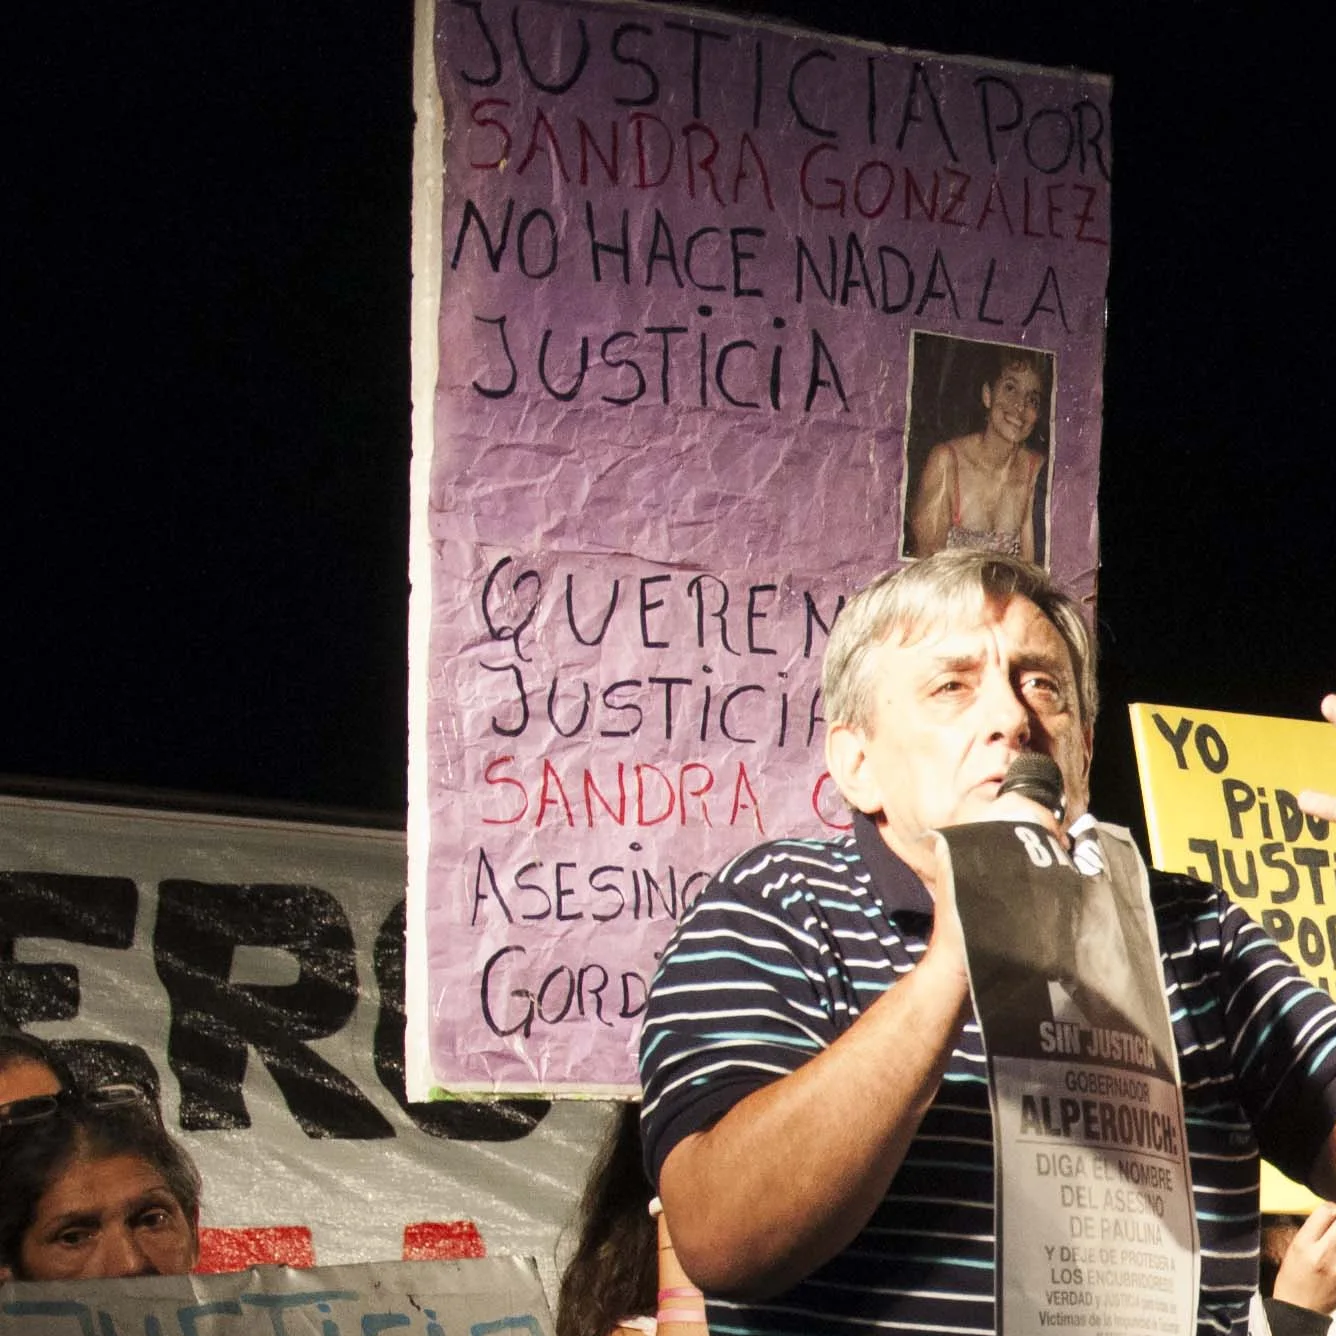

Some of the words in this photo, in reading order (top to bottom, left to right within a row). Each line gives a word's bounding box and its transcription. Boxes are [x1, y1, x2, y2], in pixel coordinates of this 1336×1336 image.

[979, 75, 1112, 182] POR
[469, 99, 775, 212] SANDRA
[799, 142, 1110, 246] GONZALEZ
[450, 200, 560, 280] NO
[584, 201, 767, 299] HACE
[795, 230, 961, 320] NADA
[977, 257, 1074, 333] LA
[1151, 713, 1230, 775] YO
[481, 754, 766, 834] SANDRA
[1039, 1020, 1081, 1057] SIN
[1065, 1070, 1151, 1103] GOBERNADOR
[1036, 1153, 1086, 1179] DIGA
[1093, 1157, 1114, 1182] EL
[1118, 1160, 1174, 1192] NOMBRE
[1060, 1185, 1099, 1209] DEL
[1103, 1188, 1165, 1218] ASESINO
[1070, 1216, 1097, 1240] DE
[1101, 1217, 1163, 1247] PAULINA
[1044, 1246, 1057, 1262] Y
[1051, 1269, 1084, 1285] LOS
[1045, 1290, 1094, 1307] VERDAD
